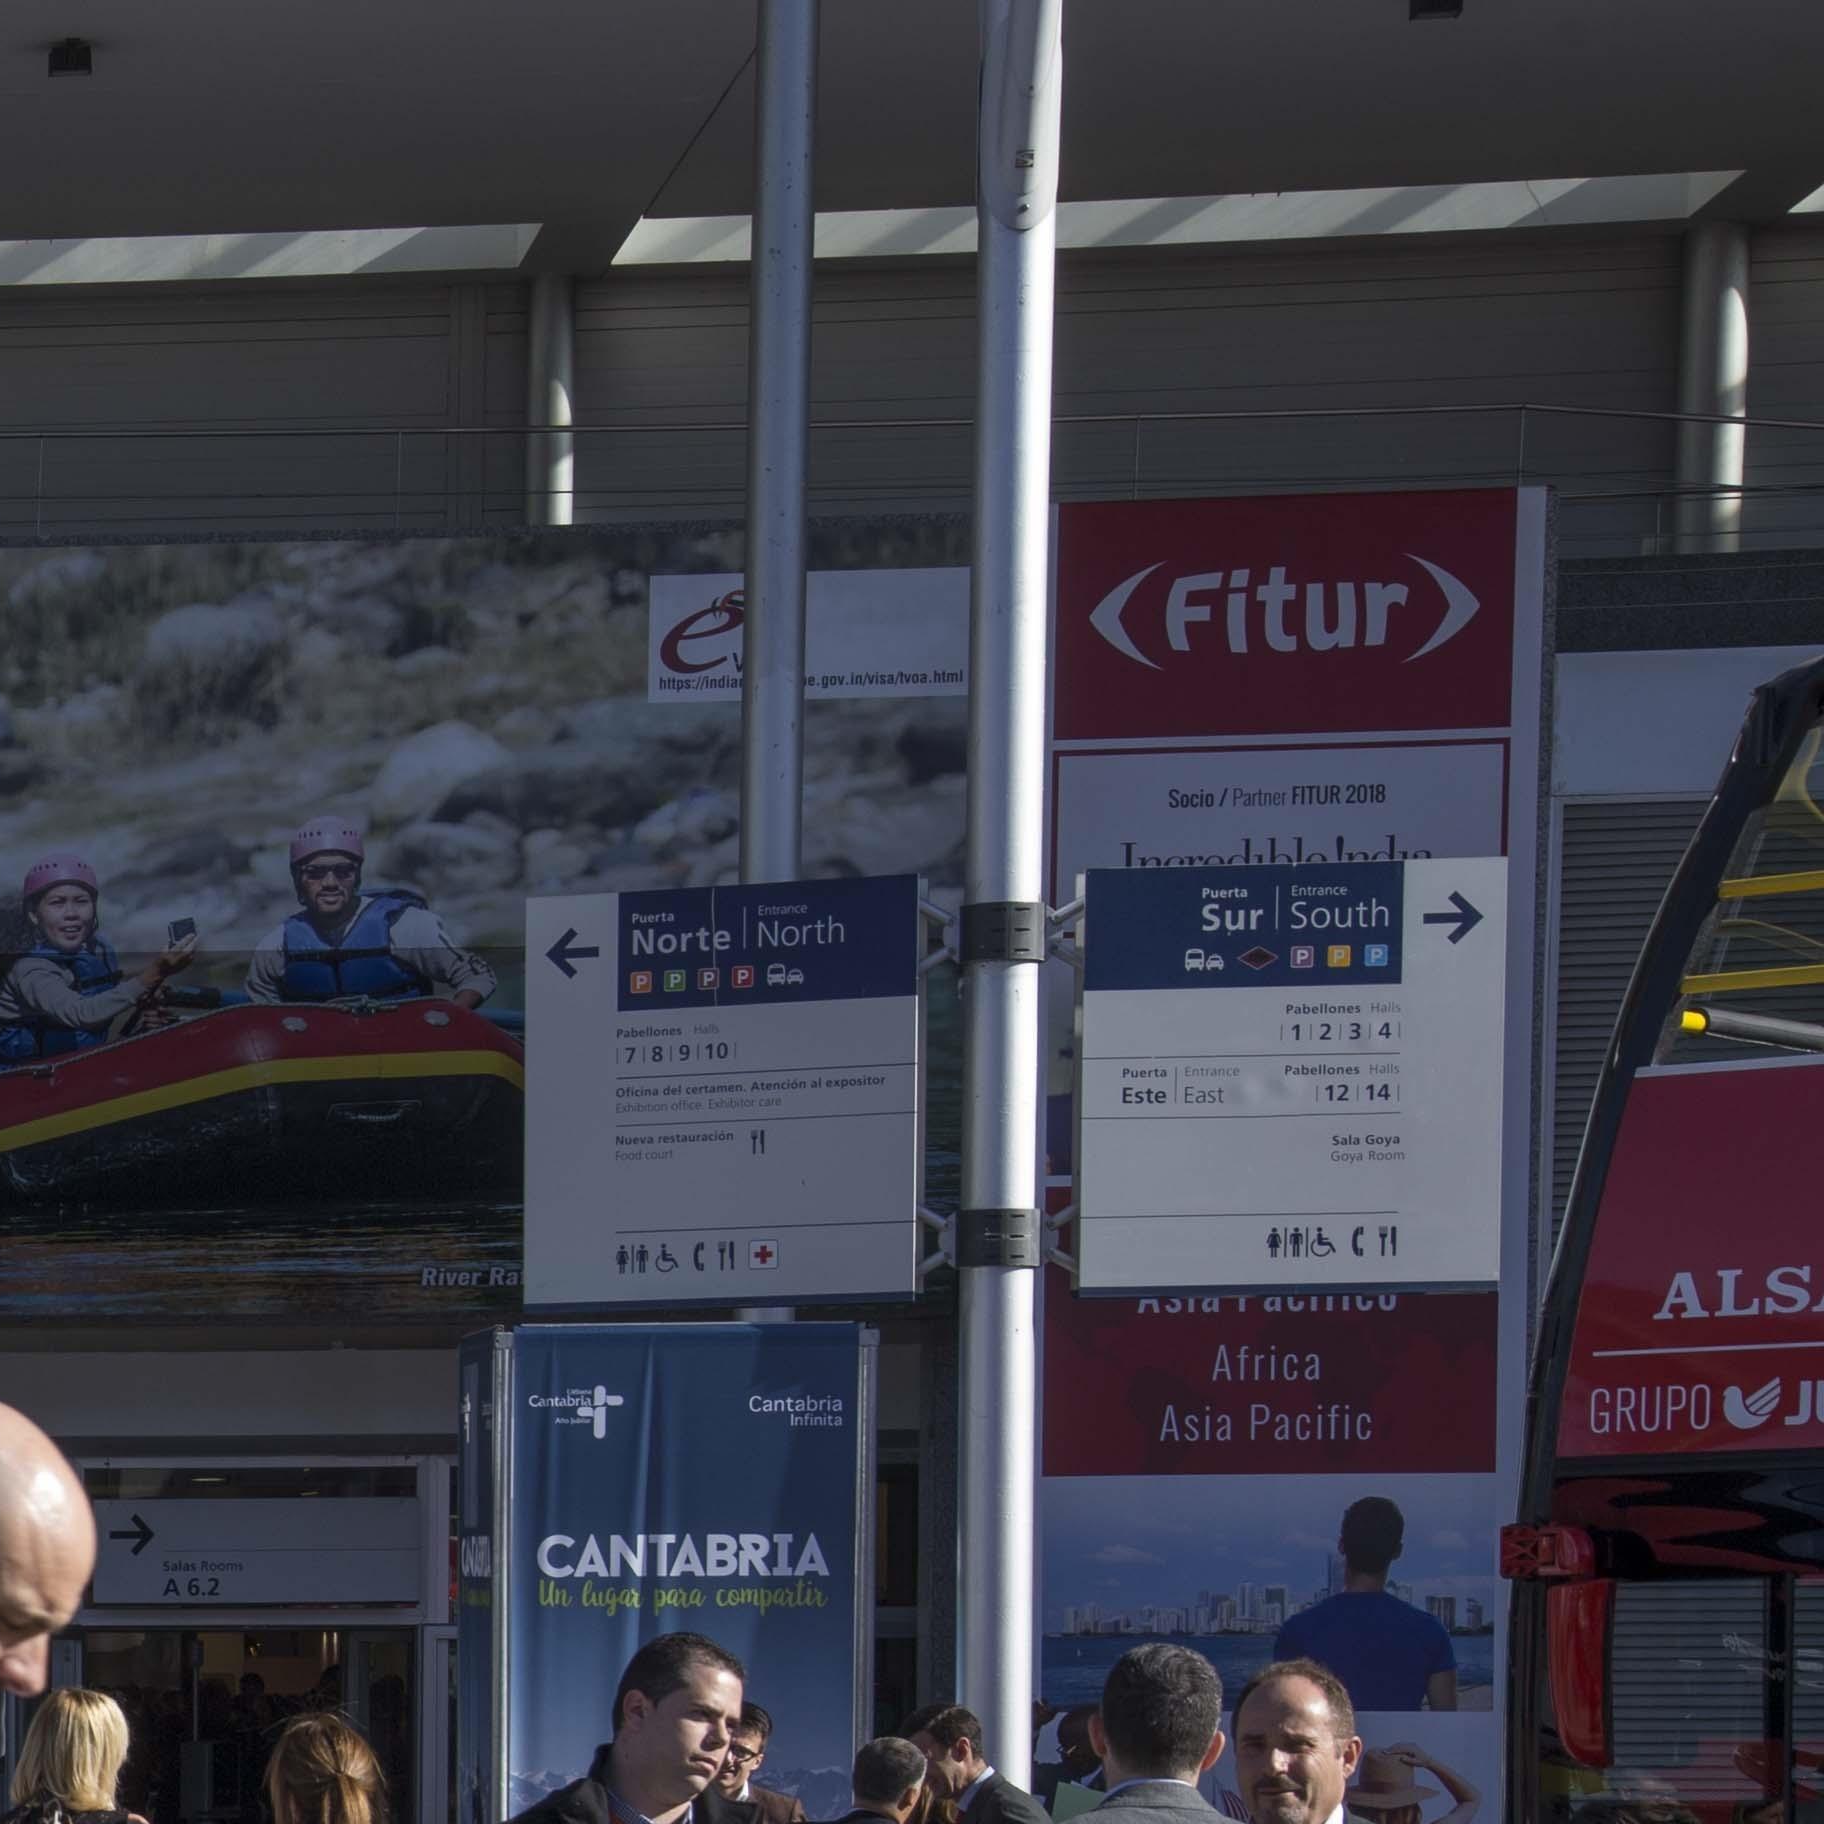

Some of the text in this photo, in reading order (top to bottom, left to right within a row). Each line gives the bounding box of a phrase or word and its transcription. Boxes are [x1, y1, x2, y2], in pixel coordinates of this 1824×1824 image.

[1165, 566, 1409, 654] Fitur
[1167, 783, 1386, 810] Socio Partner FITUR 2018
[1201, 886, 1248, 899] Puerta
[1290, 884, 1348, 897] Entrance
[631, 910, 675, 924] Puerta
[757, 902, 808, 915] Entrance
[1201, 903, 1264, 932] Sur
[1290, 896, 1390, 930] South
[631, 925, 732, 956] Norte
[756, 915, 846, 948] North
[1285, 1002, 1401, 1016] Pabellones Halls
[616, 1023, 720, 1039] Pabellones Halls
[1292, 1022, 1392, 1040] 1 2 3 4
[625, 1043, 728, 1063] 7 8 9 10
[1121, 1067, 1168, 1079] Puerta
[1183, 1065, 1241, 1078] Entrance
[1284, 1062, 1400, 1077] Pabellones Halls
[615, 1086, 659, 1099] Oficina
[662, 1084, 683, 1097] del
[751, 1079, 807, 1093] Atención
[810, 1077, 822, 1089] al
[825, 1074, 886, 1090] expositor
[1121, 1087, 1167, 1104] Este
[1183, 1086, 1225, 1104] East
[1325, 1084, 1390, 1102] 12 14
[615, 1130, 734, 1147] Nueva restauración
[1331, 1133, 1401, 1149] Sala Goya
[615, 1149, 641, 1162] Food
[1330, 1149, 1405, 1164] Goya Room
[421, 1266, 482, 1287] River
[1652, 1265, 1824, 1320] ALS
[1211, 1343, 1322, 1382] Africa
[528, 1394, 593, 1408] Cantabria
[749, 1395, 843, 1413] Cantabria
[1589, 1382, 1712, 1434] GRUPO
[790, 1413, 843, 1427] Infinita
[1159, 1404, 1373, 1442] Asia Pacific
[537, 1532, 830, 1578] CANTABRIA
[162, 1559, 244, 1573] Salas Rooms
[163, 1578, 221, 1597] A 6.2
[538, 1579, 828, 1617] Un lugar para compartir
